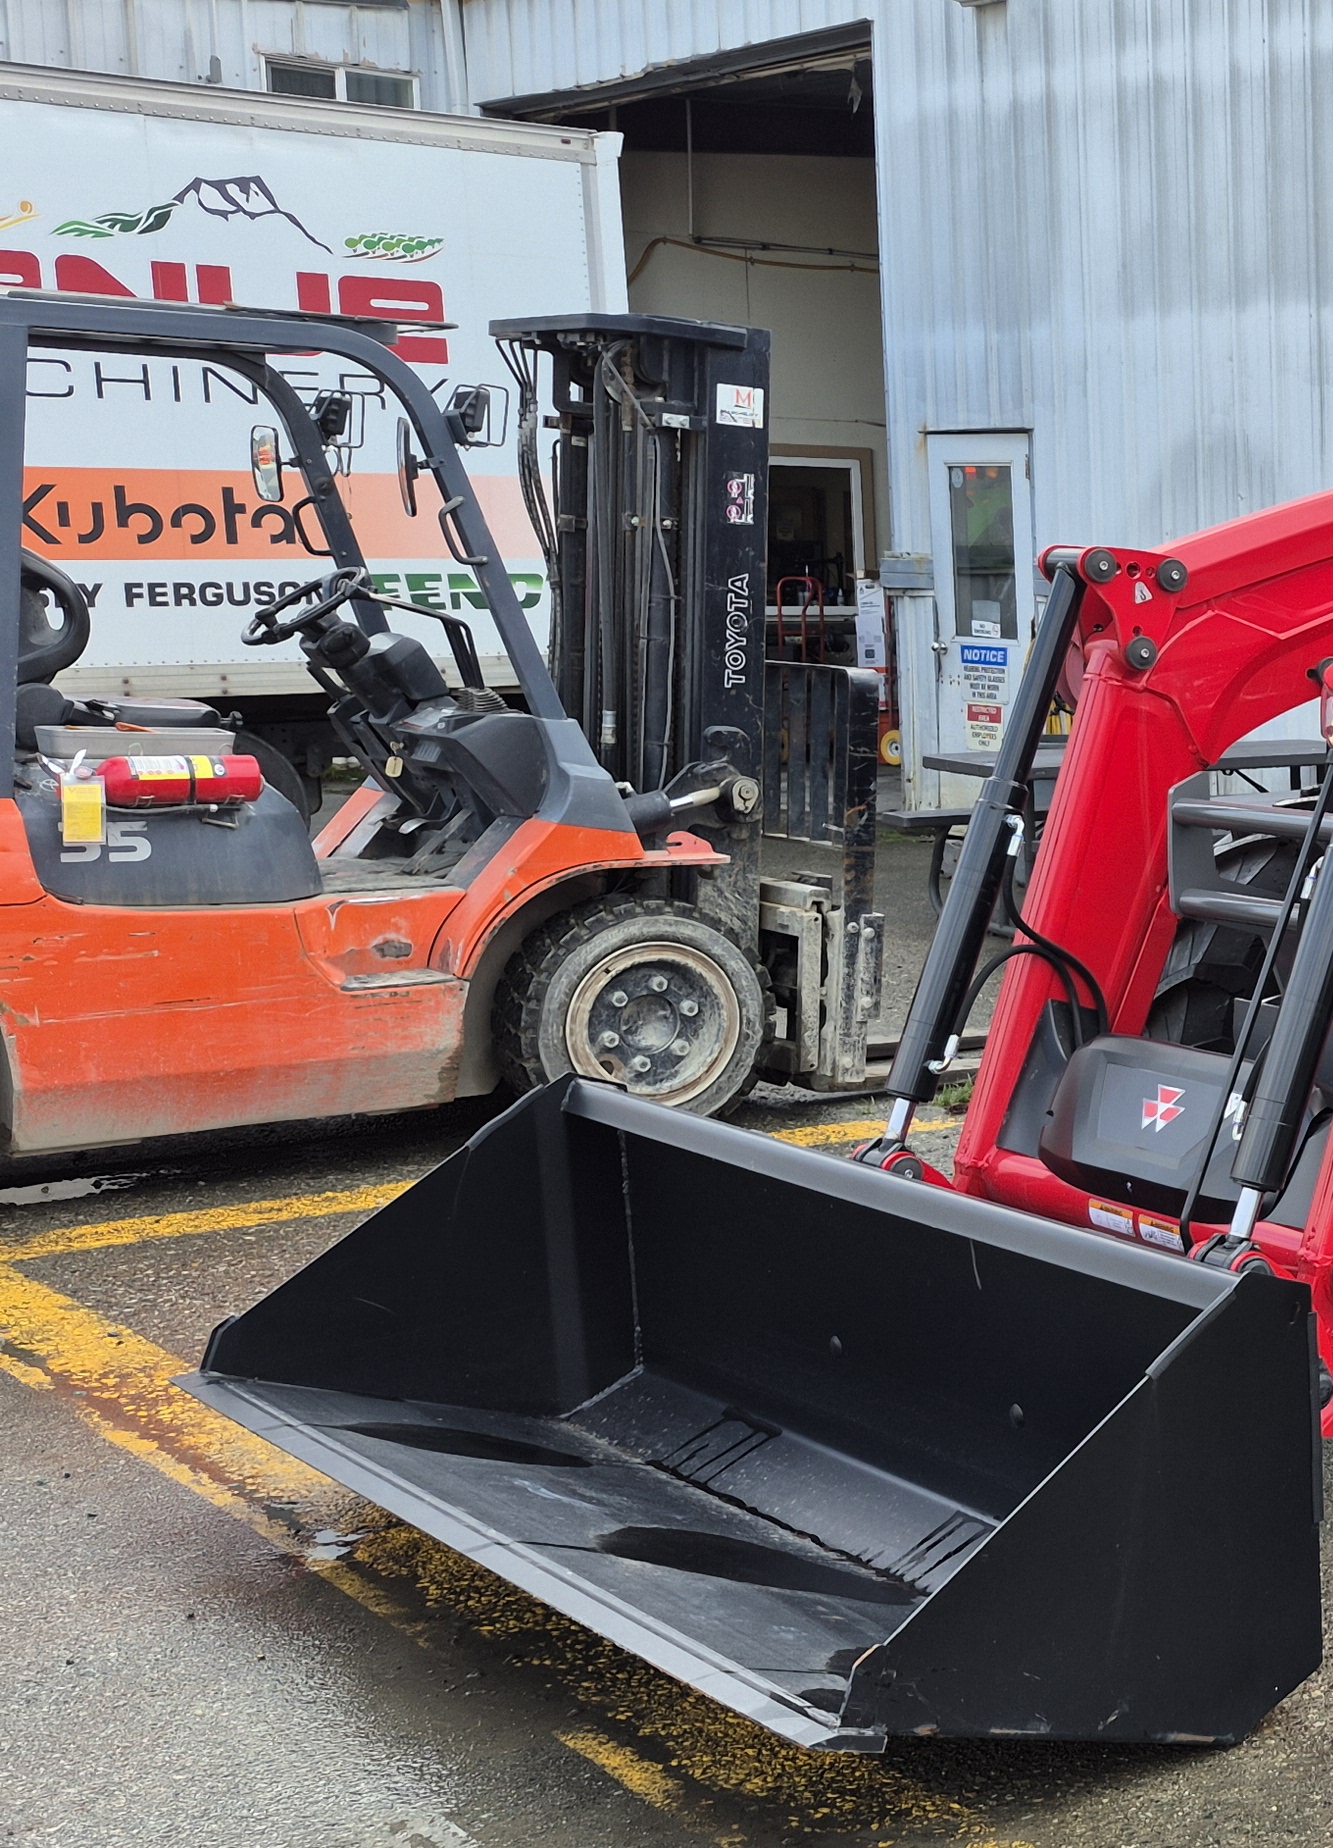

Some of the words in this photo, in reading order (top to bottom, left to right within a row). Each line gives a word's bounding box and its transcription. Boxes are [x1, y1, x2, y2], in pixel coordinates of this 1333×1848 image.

[21, 484, 298, 545] Kubota
[369, 572, 549, 611] FEND
[724, 572, 750, 689] TOYOTA
[963, 648, 1005, 663] NOTICE
